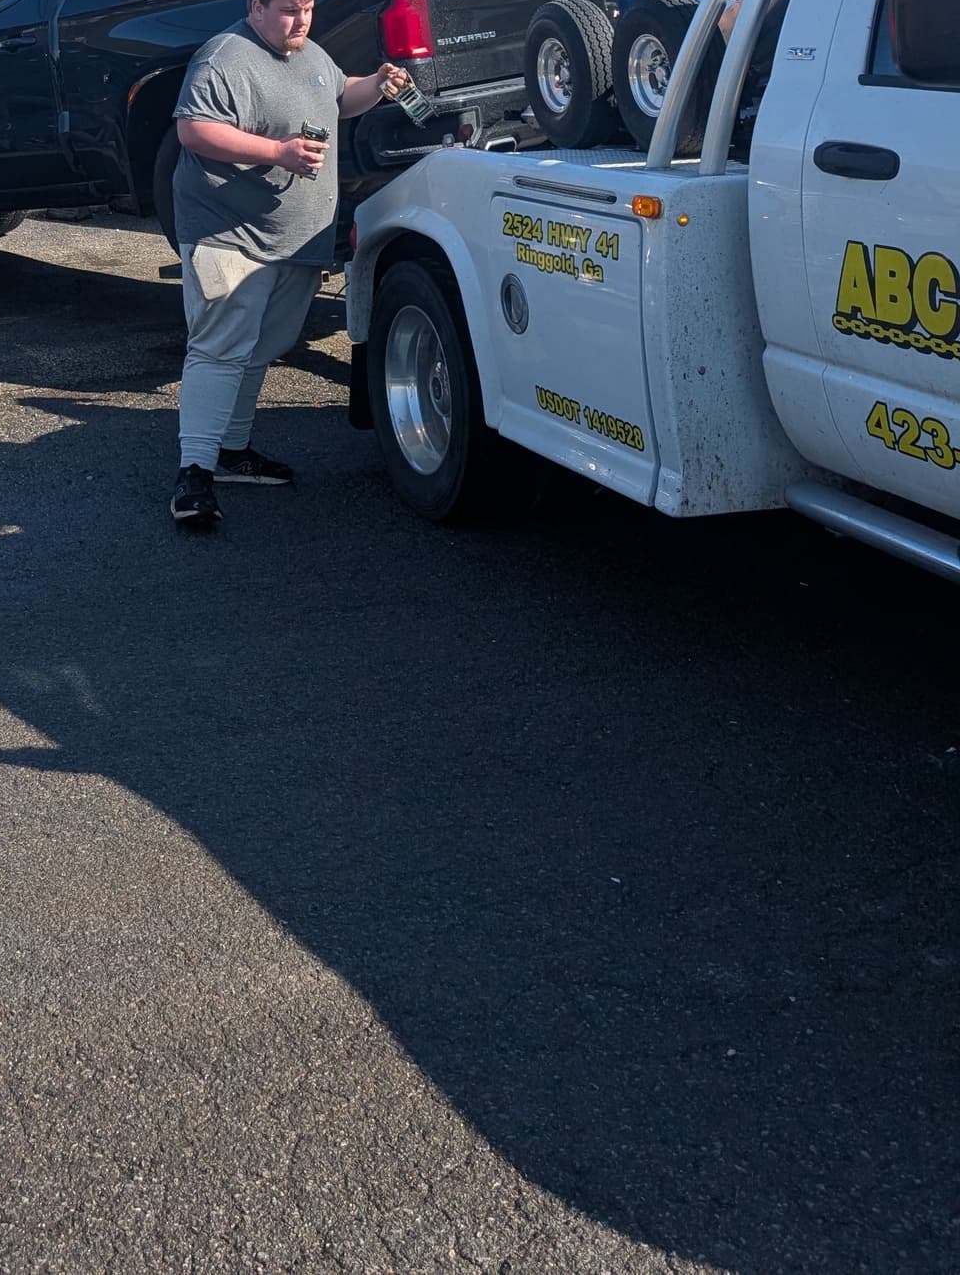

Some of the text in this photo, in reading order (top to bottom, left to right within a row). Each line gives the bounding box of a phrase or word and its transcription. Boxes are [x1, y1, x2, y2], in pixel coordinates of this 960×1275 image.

[437, 30, 496, 45] SILVERADO
[503, 212, 619, 261] 2524 HWY 41
[516, 242, 604, 283] Ringgold, Ga
[836, 240, 959, 338] ABC
[535, 385, 644, 452] USDOT 1419528
